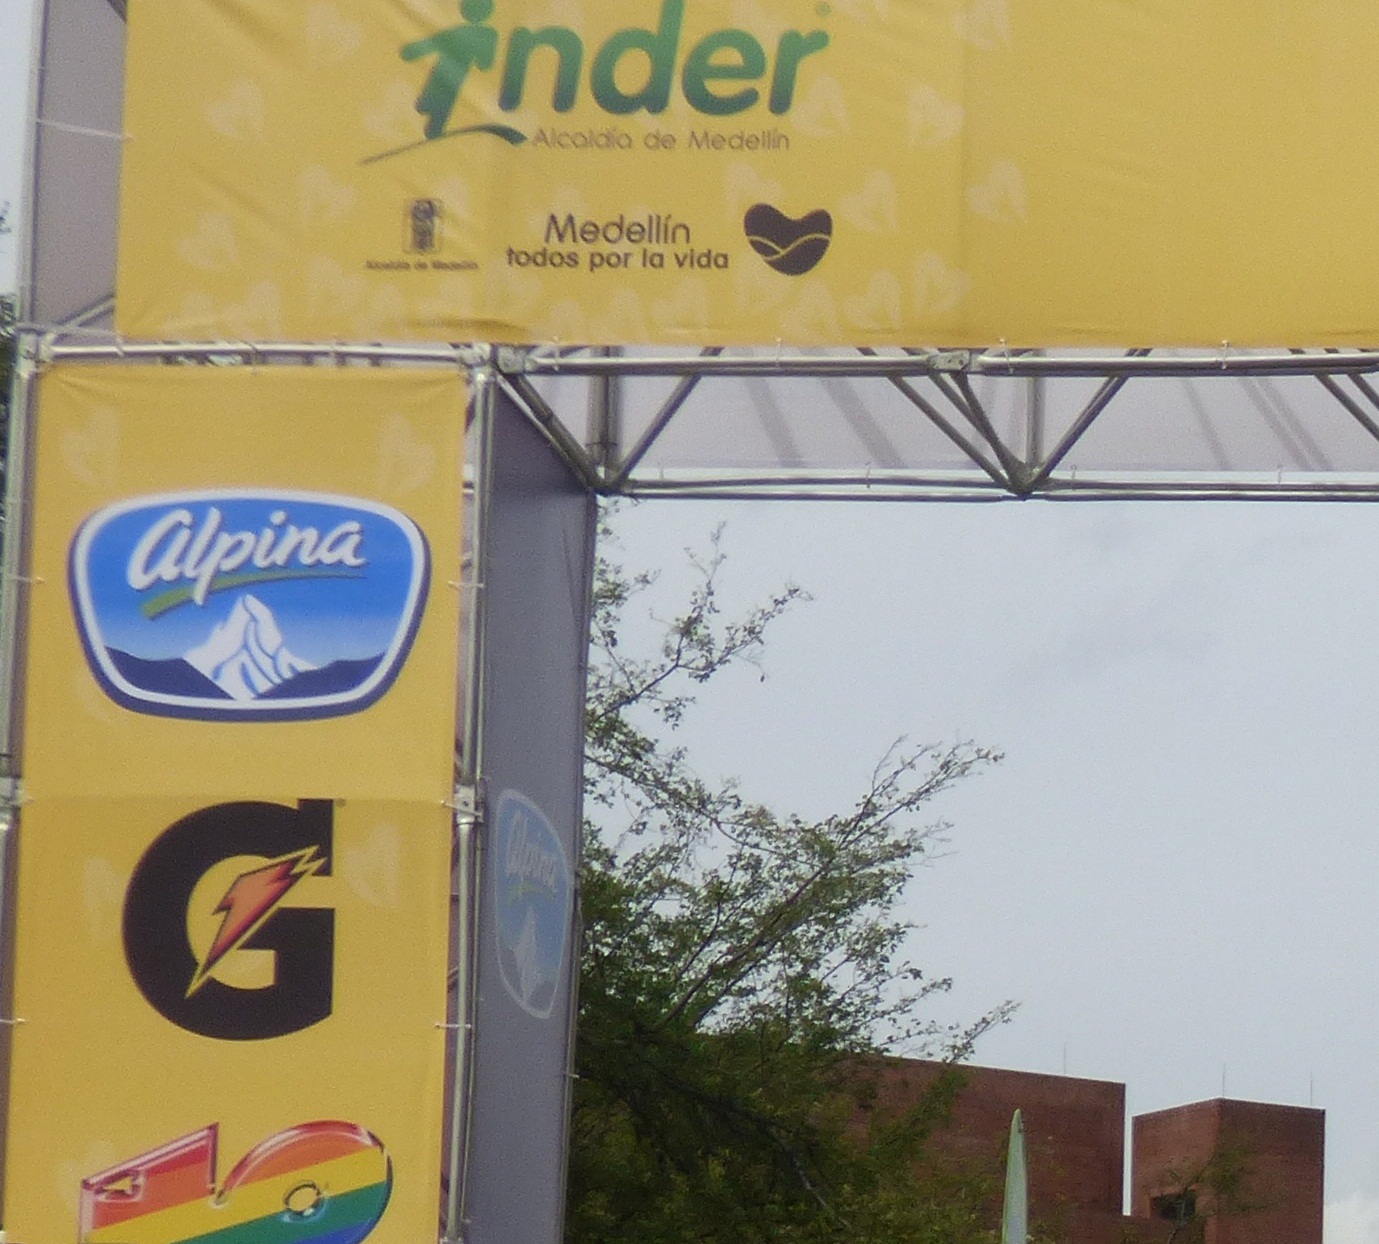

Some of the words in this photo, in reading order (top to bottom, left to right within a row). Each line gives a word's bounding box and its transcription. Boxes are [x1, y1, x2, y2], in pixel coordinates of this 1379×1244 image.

[532, 127, 632, 151] Alcaldía
[644, 128, 677, 151] de
[688, 128, 791, 152] Medellín
[544, 211, 691, 245] Medellín
[507, 247, 579, 269] todos
[589, 250, 632, 272] por
[642, 247, 666, 269] la
[676, 247, 730, 269] vida
[127, 507, 367, 606] Alpina
[122, 798, 334, 1041] G
